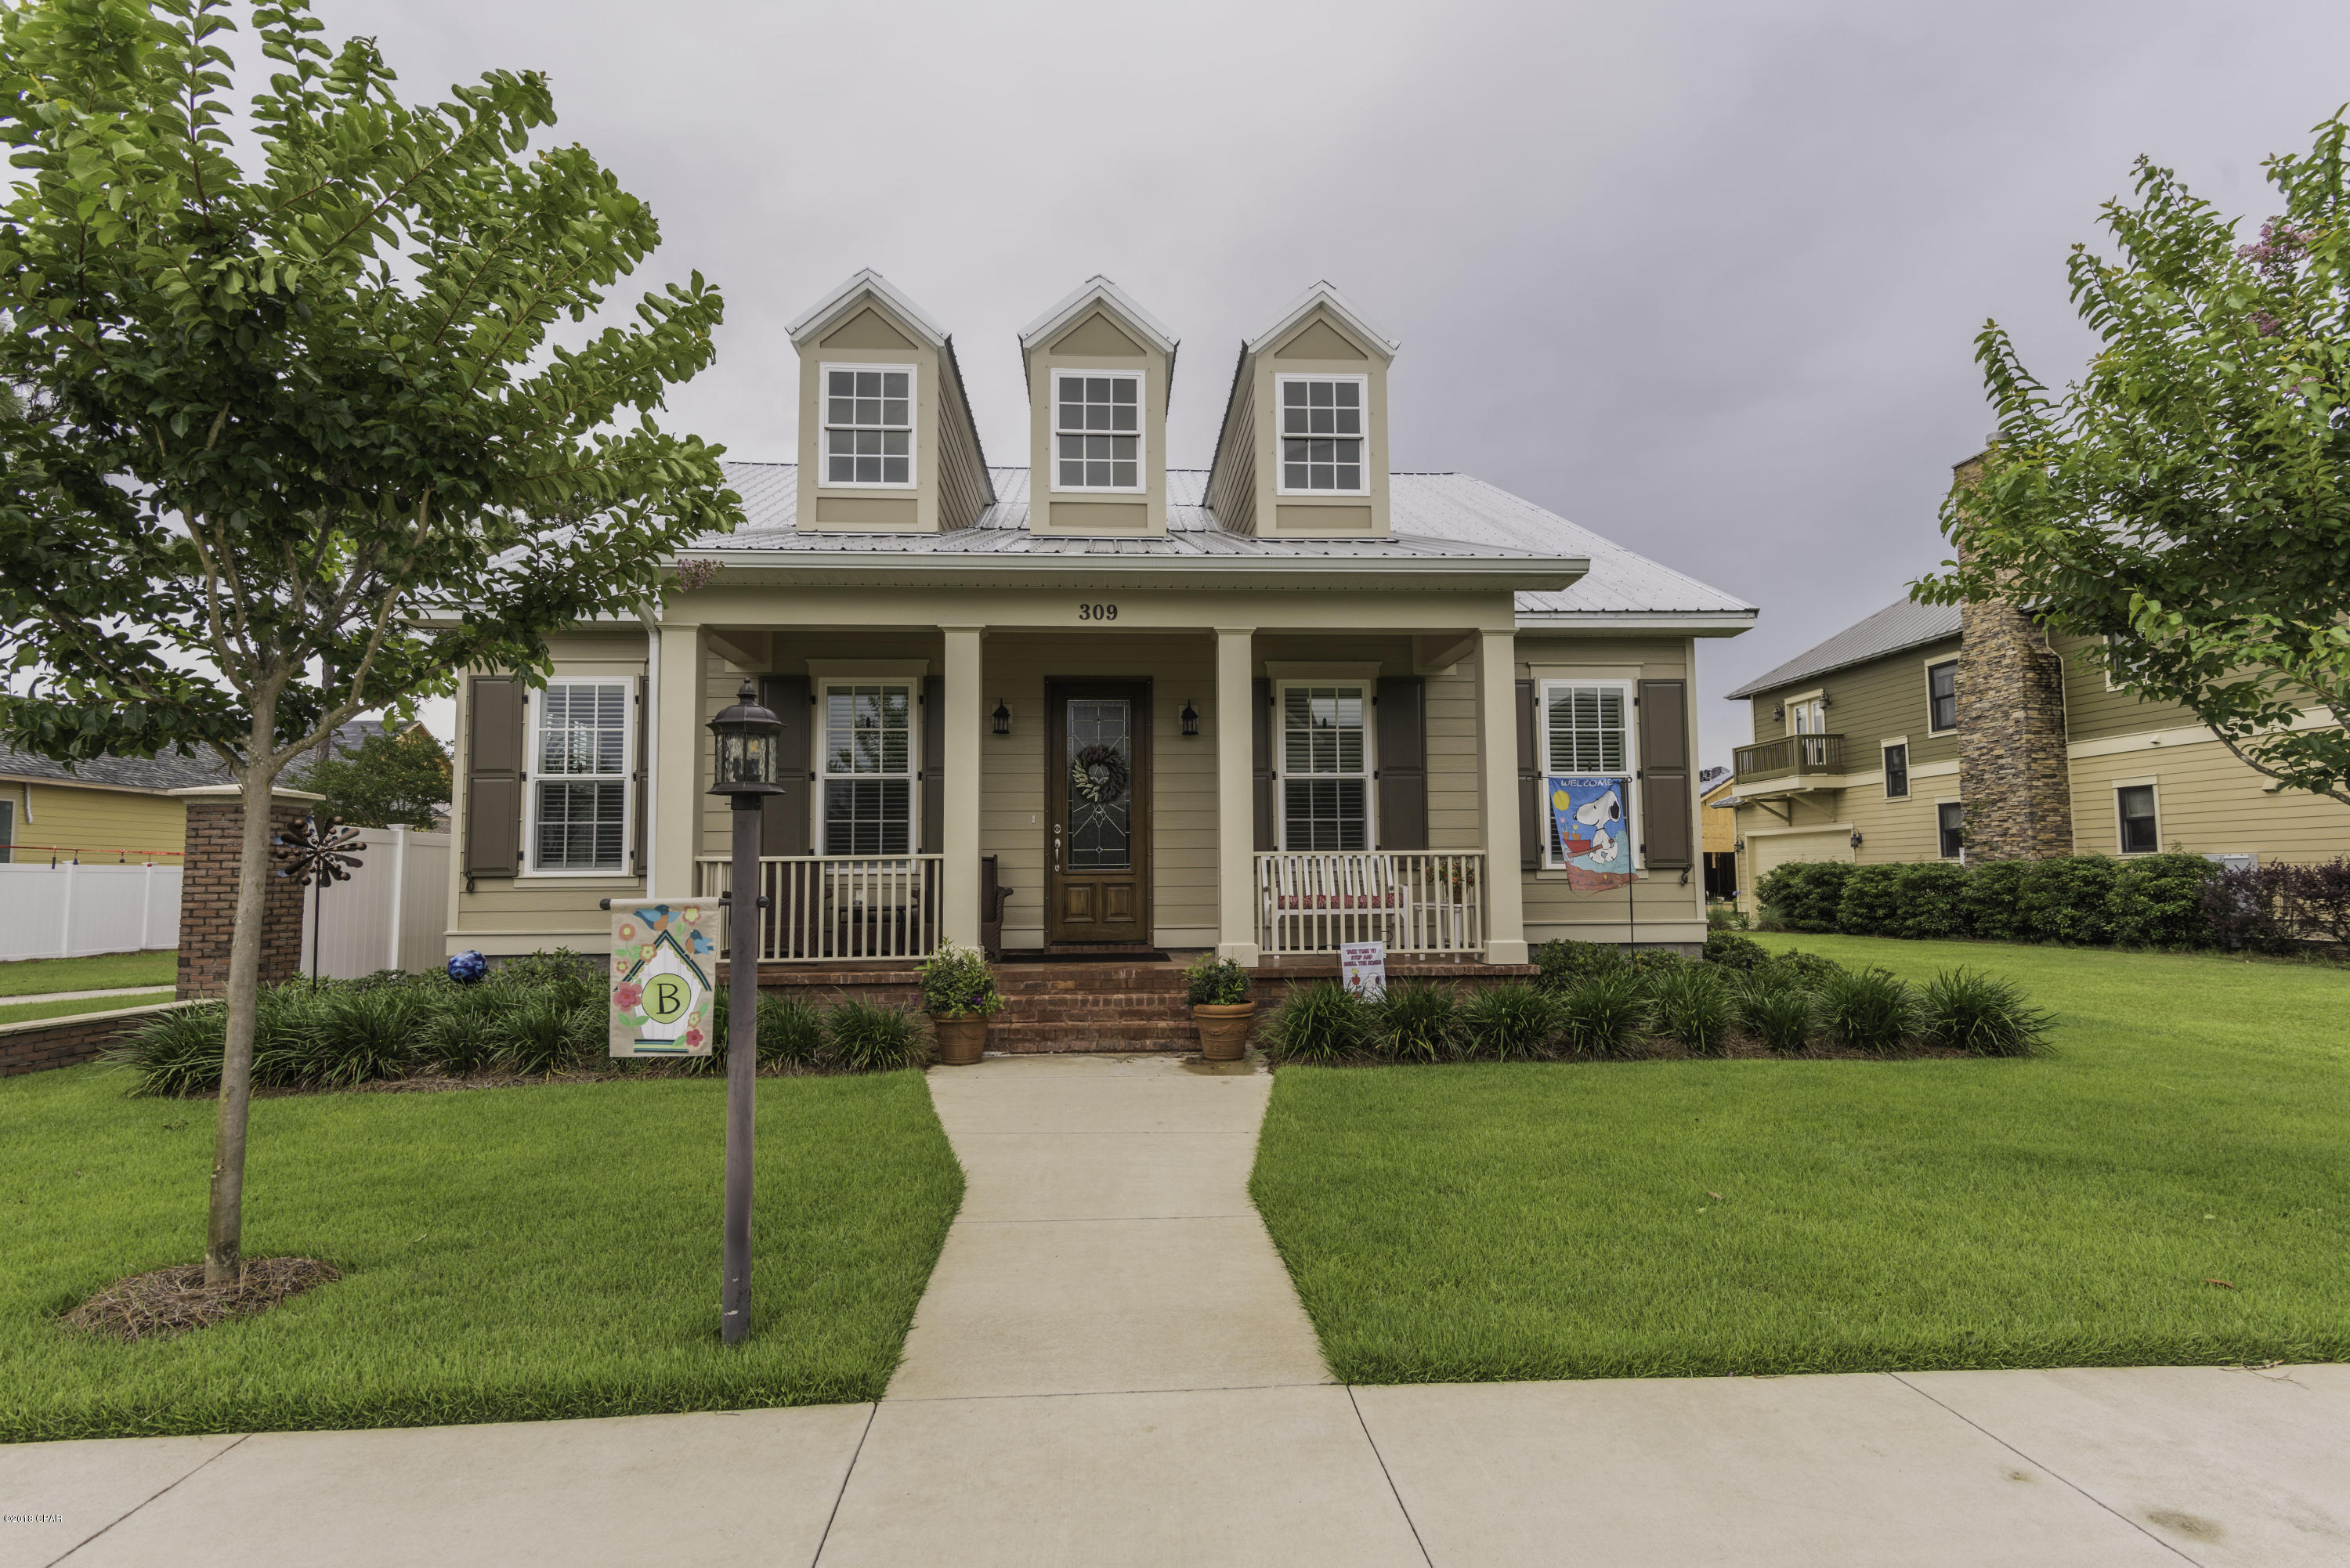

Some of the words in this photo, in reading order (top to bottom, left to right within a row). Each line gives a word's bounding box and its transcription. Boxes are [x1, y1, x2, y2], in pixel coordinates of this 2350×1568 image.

[1079, 603, 1118, 620] 309
[1560, 779, 1613, 787] WELCOME
[656, 983, 681, 1014] B
